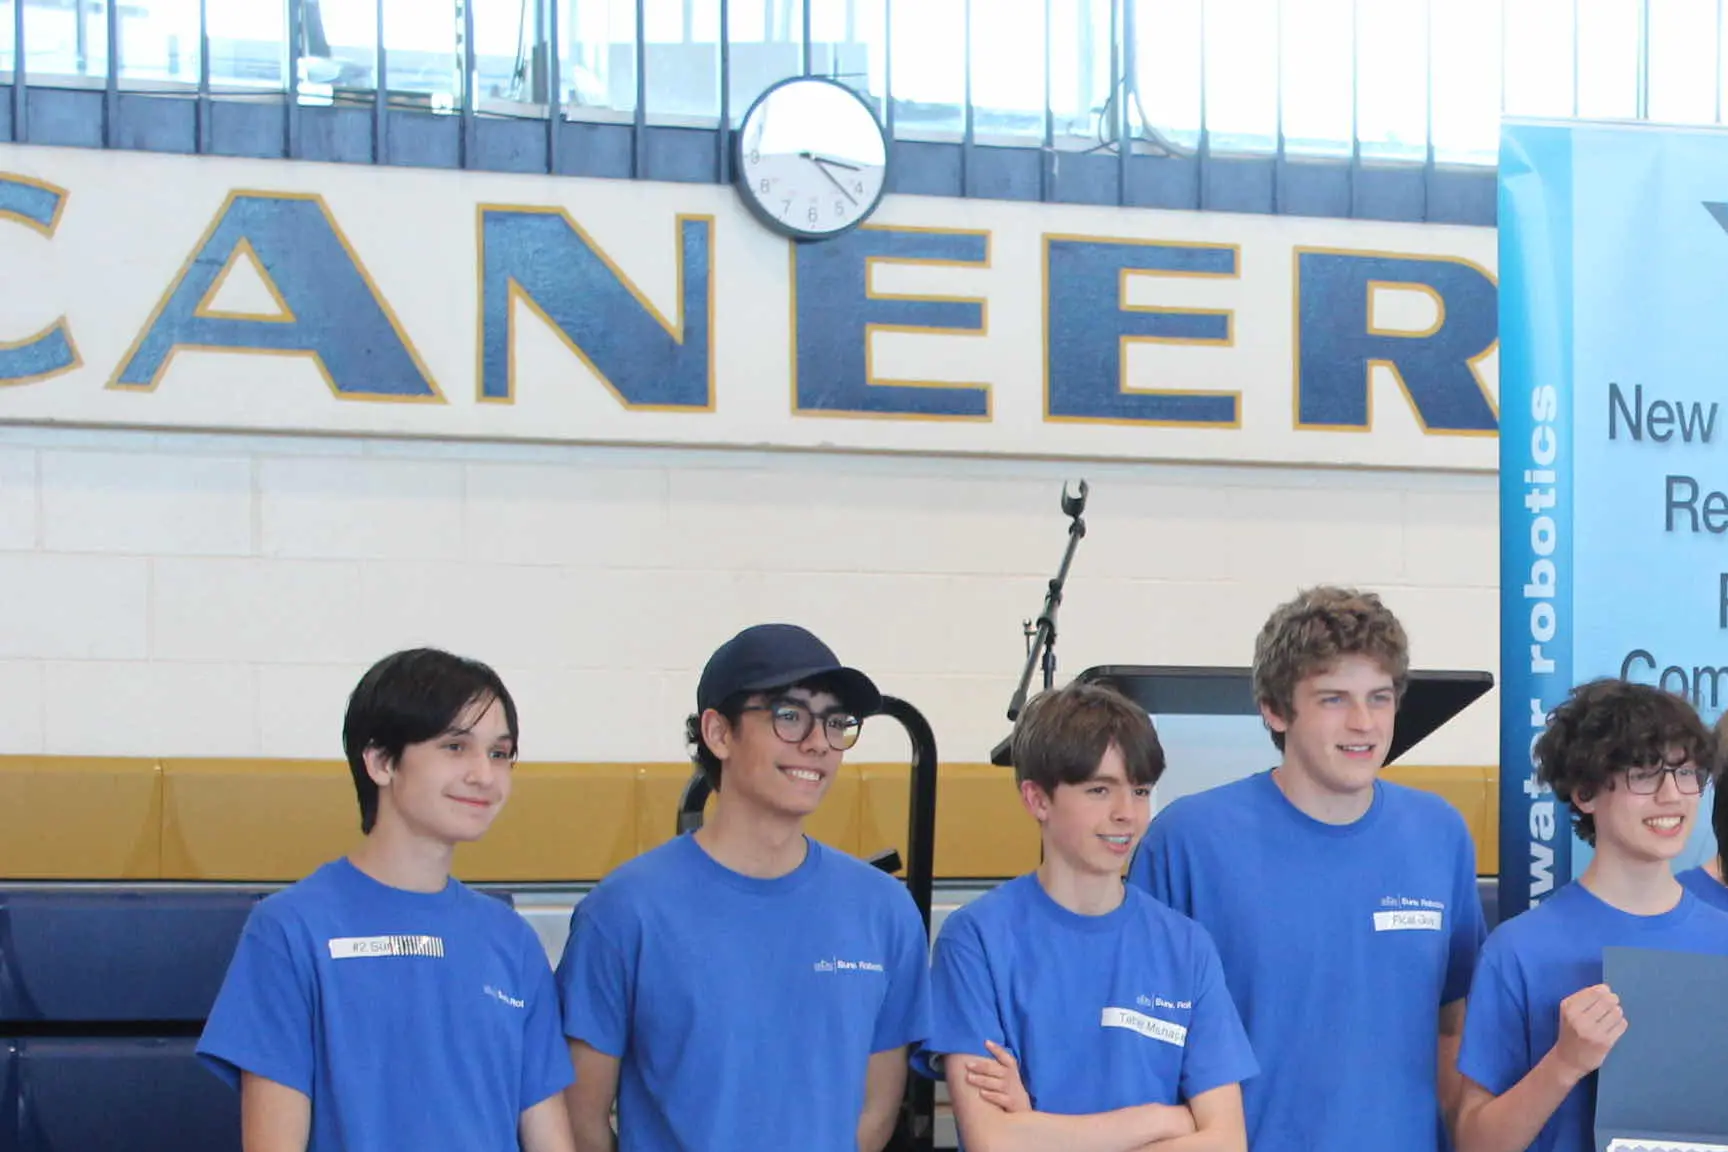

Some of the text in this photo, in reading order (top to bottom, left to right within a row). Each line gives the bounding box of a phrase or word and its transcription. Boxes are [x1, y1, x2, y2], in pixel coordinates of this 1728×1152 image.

[855, 181, 864, 194] 4
[781, 200, 792, 215] 7
[808, 206, 818, 223] 6
[835, 201, 845, 216] 5
[1608, 382, 1718, 443] New
[1524, 384, 1557, 673] robotics
